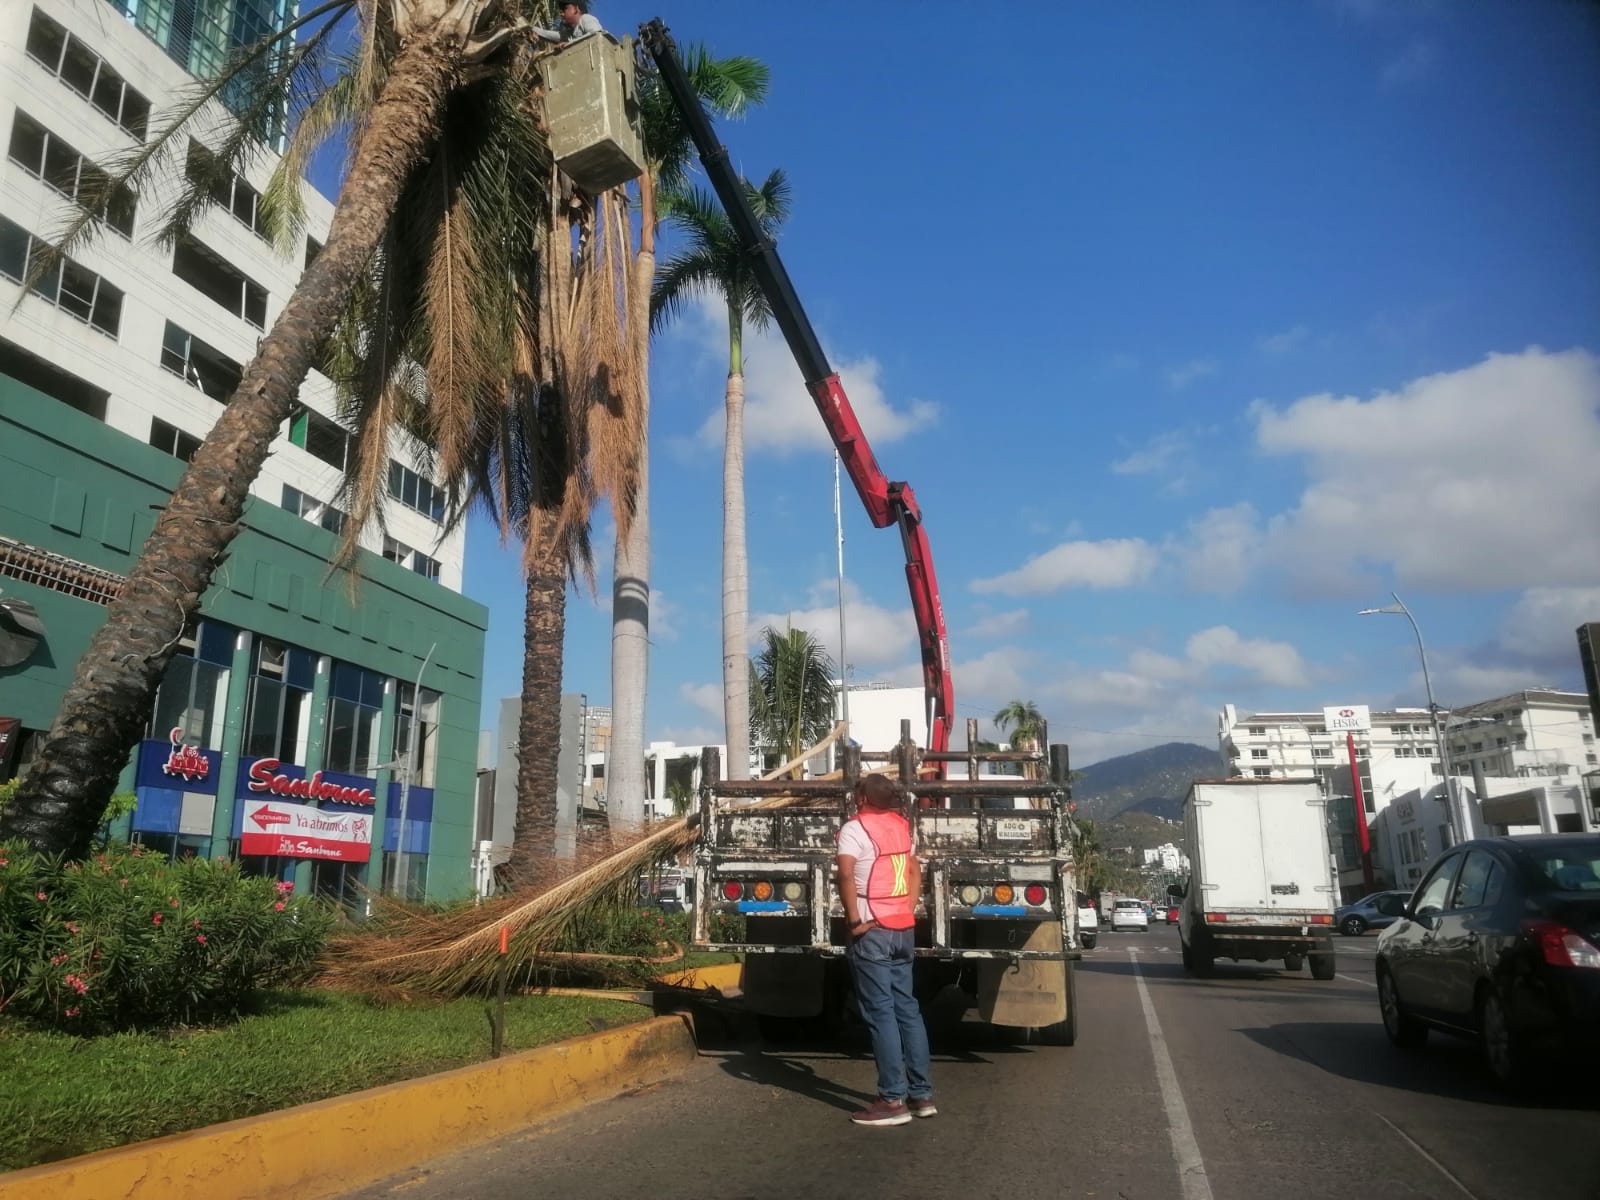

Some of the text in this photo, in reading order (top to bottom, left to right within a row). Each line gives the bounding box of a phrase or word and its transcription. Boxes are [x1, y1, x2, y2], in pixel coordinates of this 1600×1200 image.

[1333, 718, 1361, 728] HSBC
[248, 758, 376, 806] Sanborns
[296, 813, 308, 828] Ya
[310, 815, 348, 832] abrimos
[296, 840, 342, 856] Sanborns
